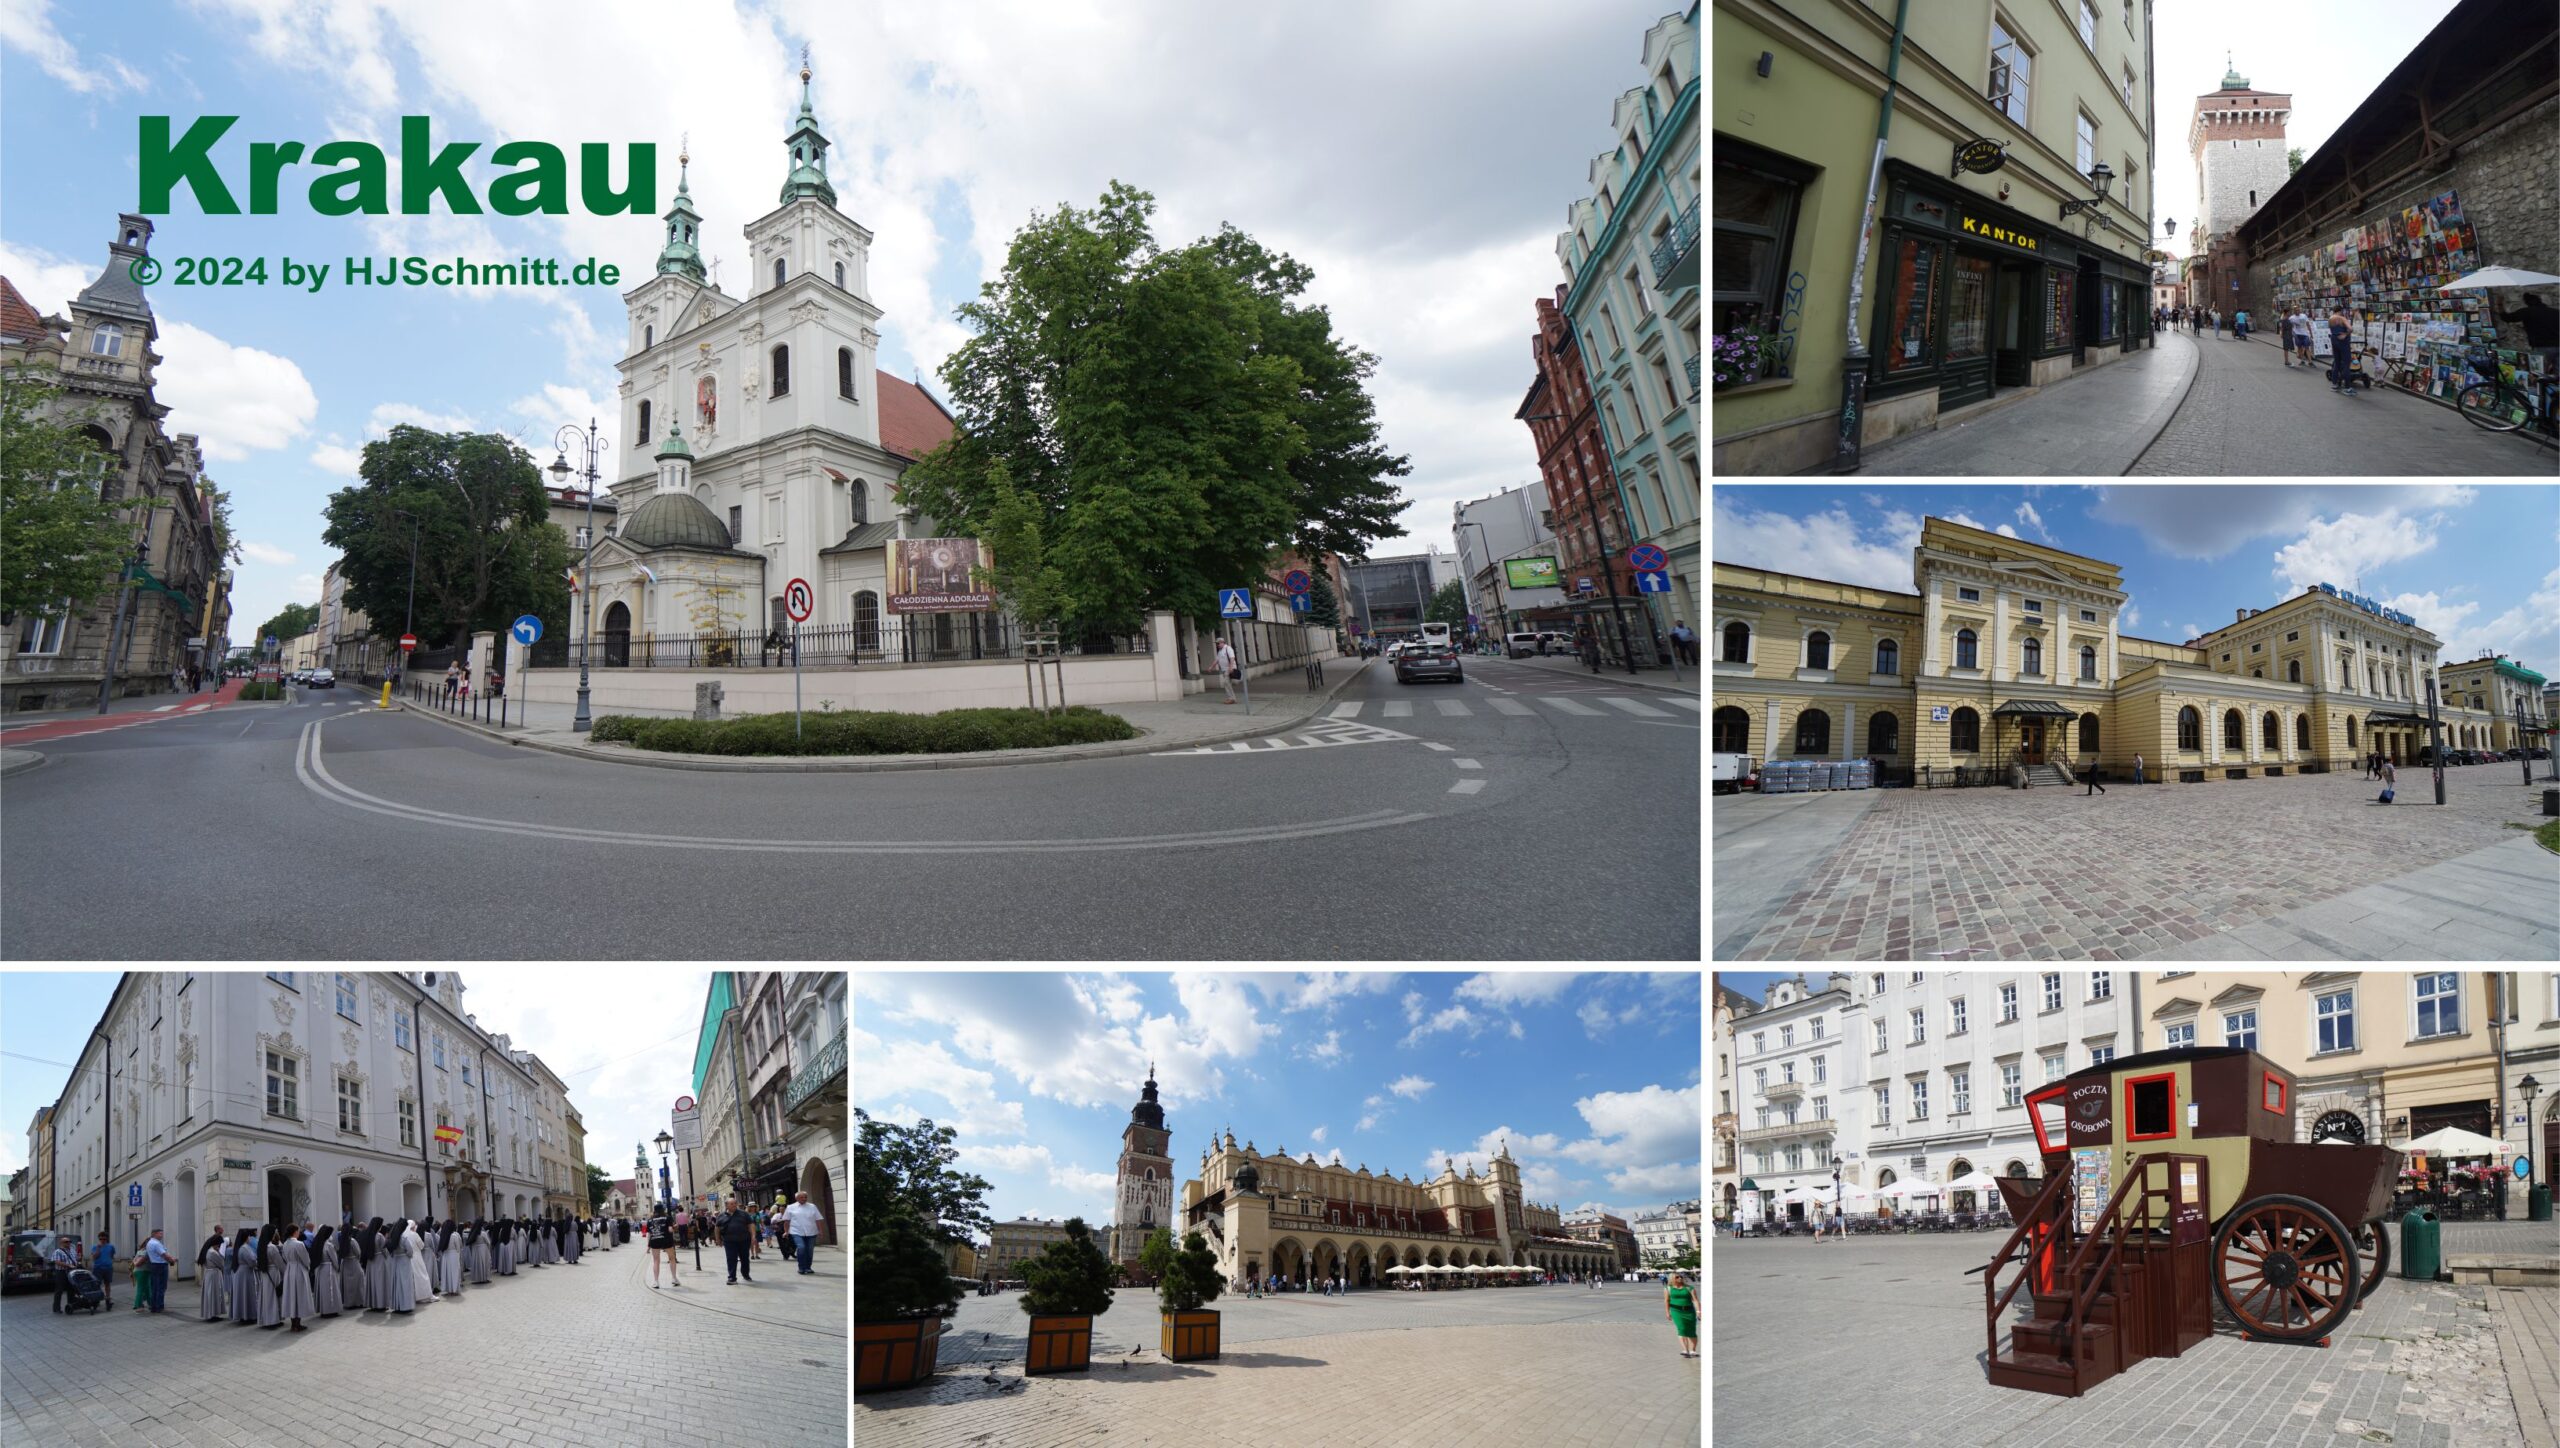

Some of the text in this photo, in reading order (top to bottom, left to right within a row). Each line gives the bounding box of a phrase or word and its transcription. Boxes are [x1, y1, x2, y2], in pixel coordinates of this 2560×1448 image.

[1964, 145, 1999, 161] KANTOR
[1963, 217, 2037, 250] KANTOR
[894, 594, 990, 605] CAŁODZIENNA ADORACJA
[2072, 1085, 2107, 1100] POCZTA
[2070, 1118, 2112, 1133] OSOBOWA
[2313, 1112, 2363, 1139] RESTAURACJA
